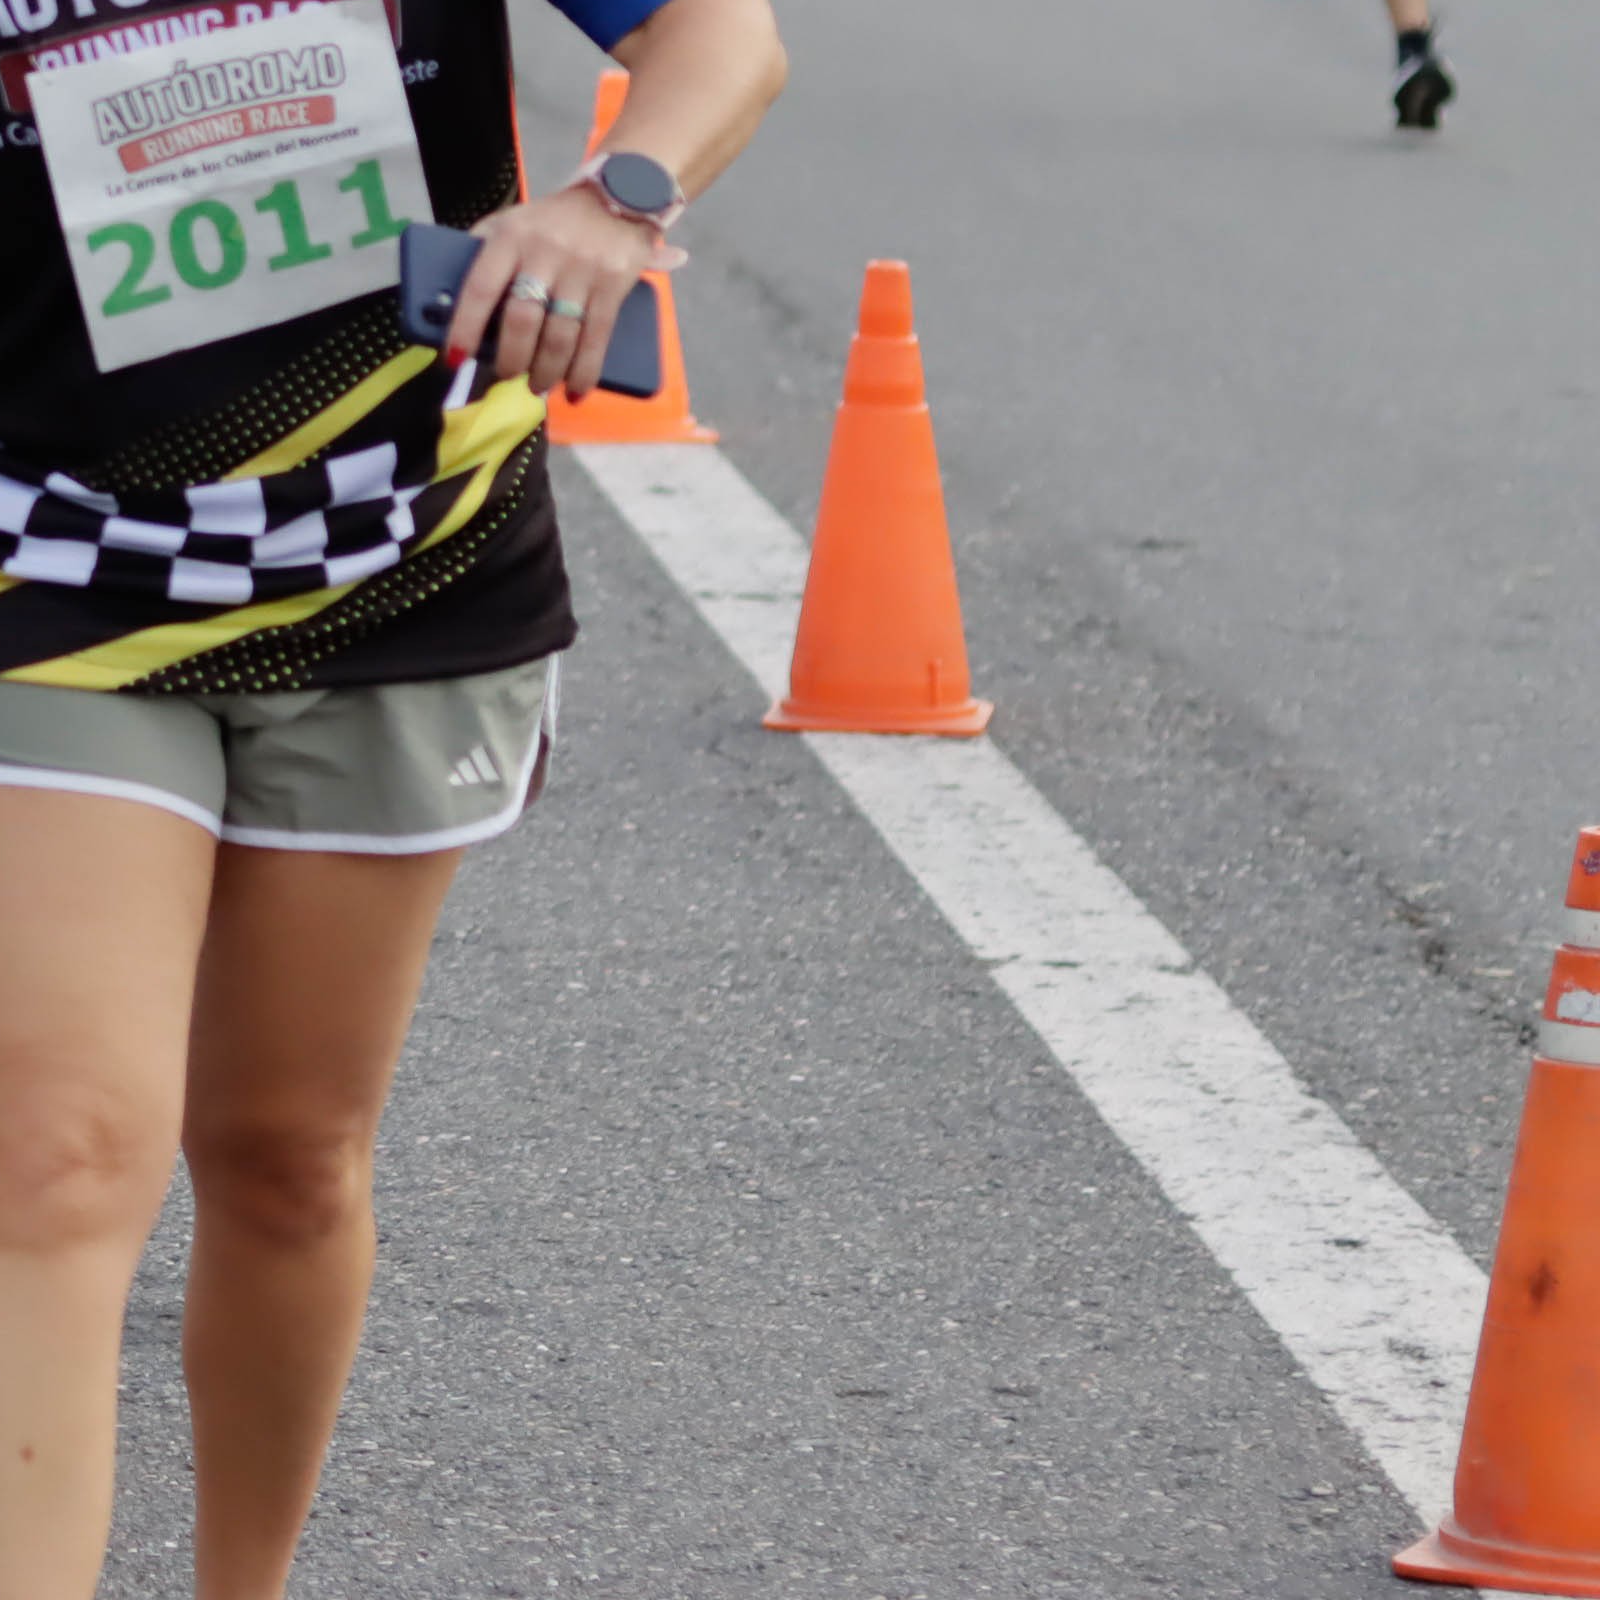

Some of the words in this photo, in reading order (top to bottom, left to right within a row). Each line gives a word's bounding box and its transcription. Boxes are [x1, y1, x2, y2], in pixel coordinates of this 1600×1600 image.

[92, 43, 347, 145] AUTÓDROMO
[140, 111, 245, 163] RUNNING
[249, 102, 311, 132] RACE
[125, 172, 178, 194] Carrera
[181, 164, 199, 180] de
[224, 149, 272, 169] Clubes
[299, 127, 360, 148] Noroeste
[85, 159, 413, 317] 2011
